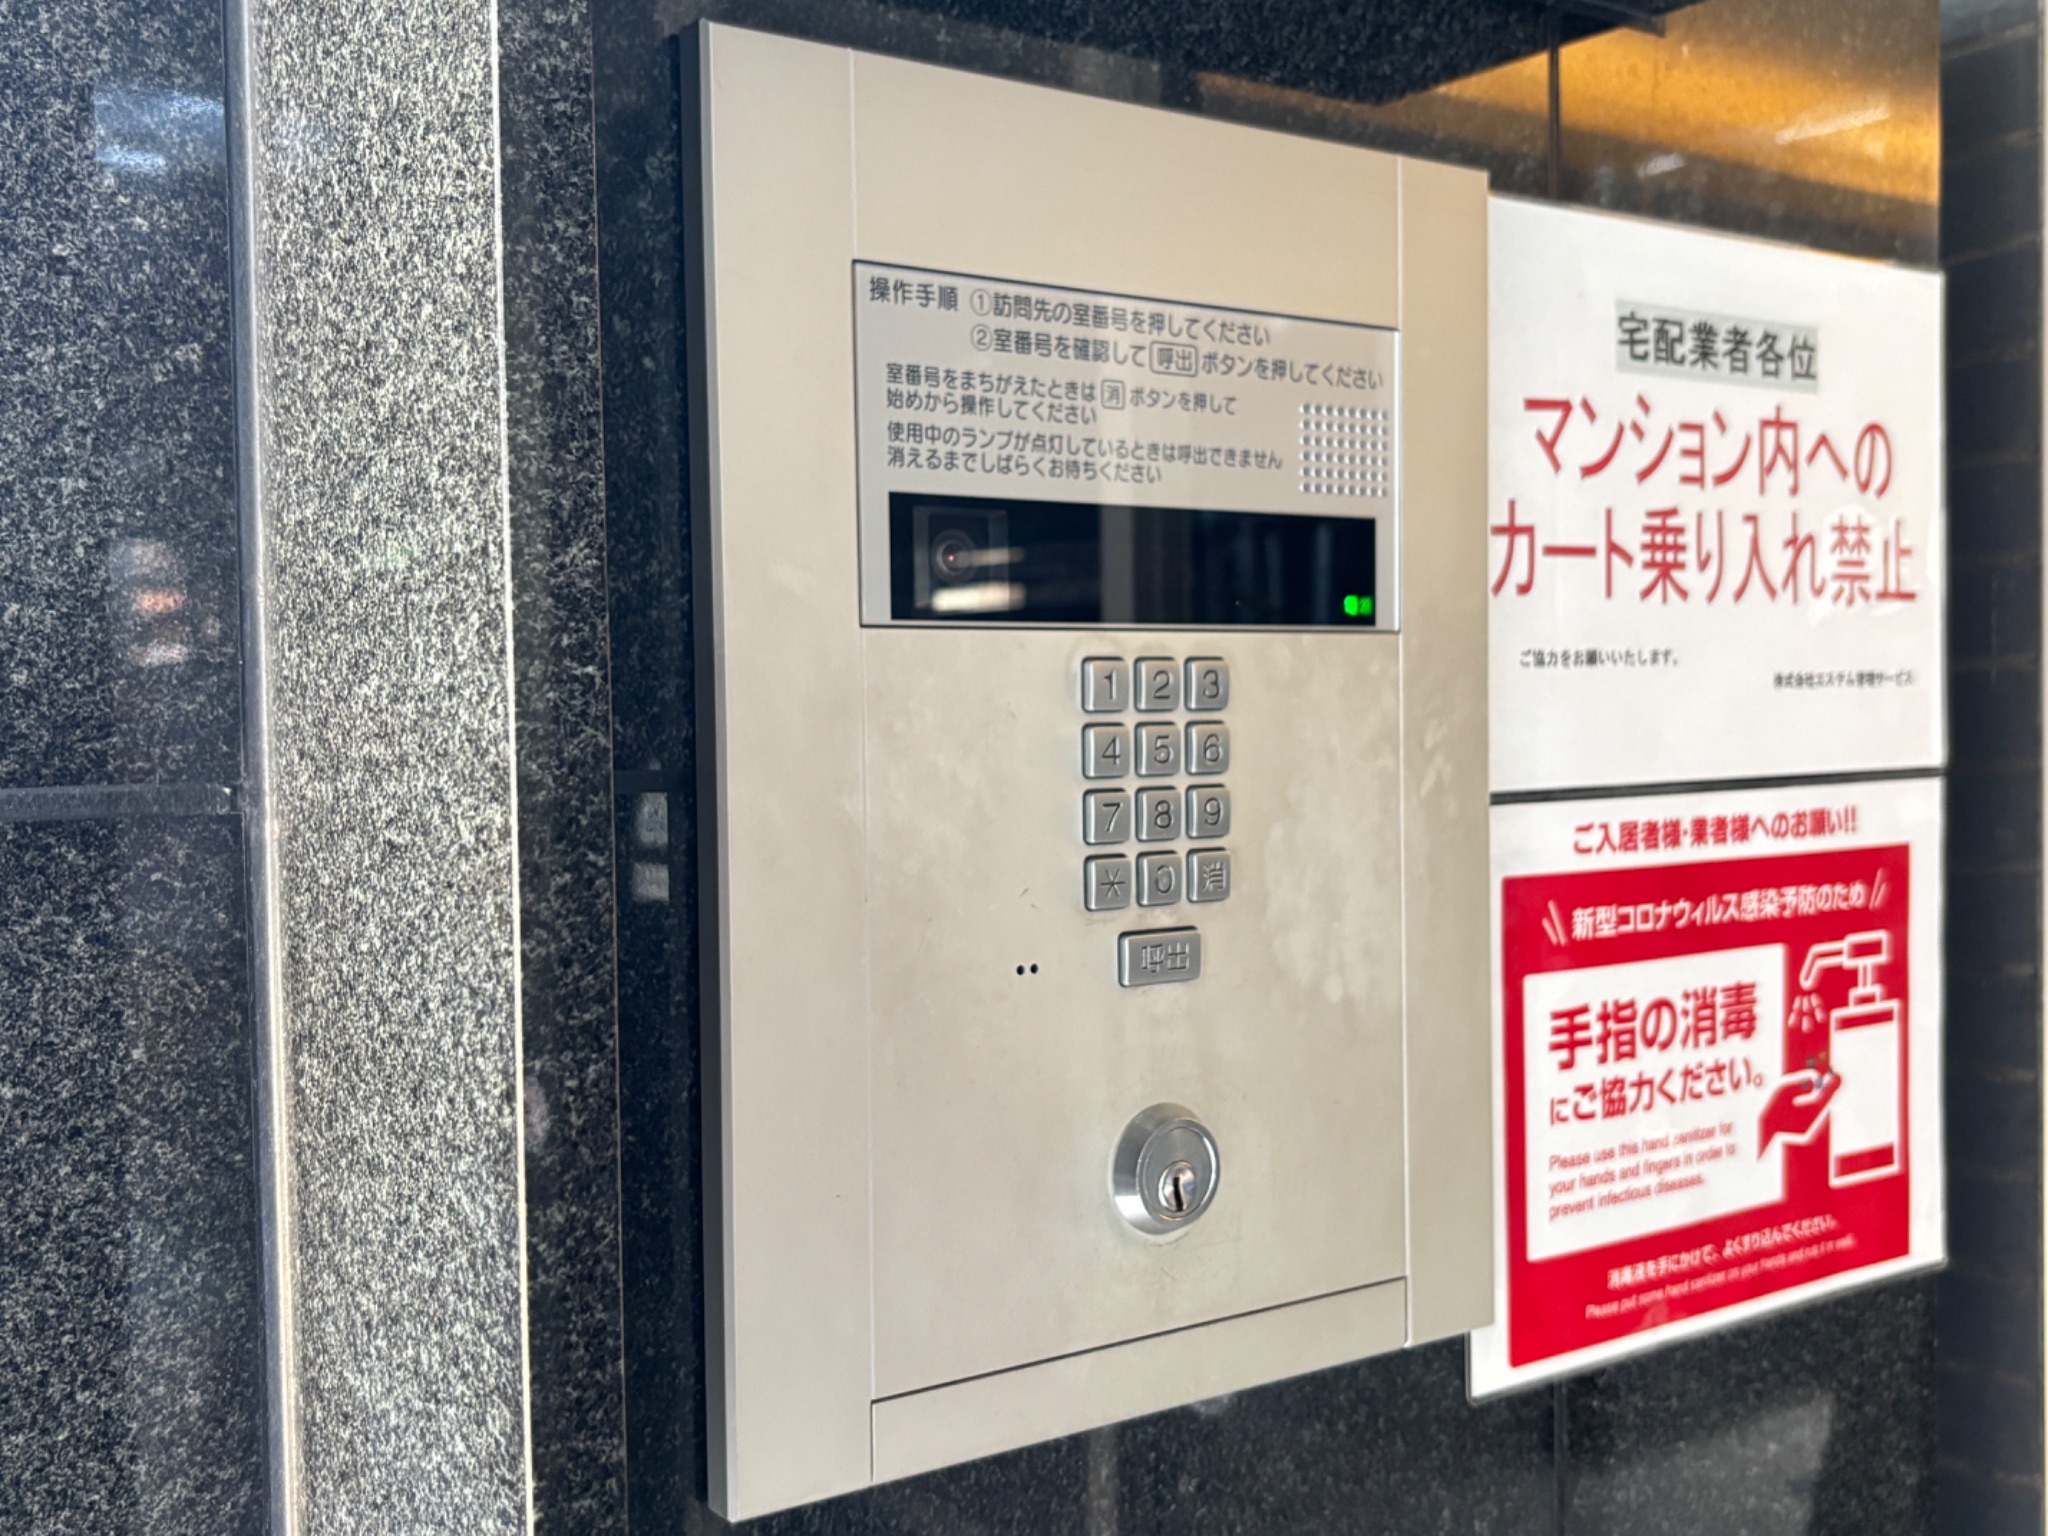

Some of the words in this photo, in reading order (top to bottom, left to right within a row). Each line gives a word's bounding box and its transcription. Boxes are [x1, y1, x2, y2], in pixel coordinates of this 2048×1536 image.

[869, 276, 959, 312] 操作手順
[970, 288, 1271, 347] ①訪問先の室番号を押してください
[970, 323, 1147, 368] ②室番号を確認して
[1156, 347, 1194, 373] 呼出
[1201, 352, 1384, 390] ボタンを押してください
[1616, 311, 1818, 381] 宅配業者各位
[886, 362, 1097, 402] 室番号をまちがえたときは
[1129, 388, 1237, 416] ボタンを押して
[886, 388, 1098, 426] 始めから操作してください
[887, 420, 1282, 471] 使用中のランプが点灯しているときは呼出できません
[887, 446, 1162, 484] 消えるまでしばらくお待ちください
[1523, 393, 1893, 499] マンション内への
[1490, 498, 1917, 606] カート乗り入れ禁止
[1519, 648, 1679, 668] ご協力をお願いいたします。
[1103, 669, 1117, 701] 1
[1152, 670, 1172, 700] 2
[1202, 669, 1221, 699] 3
[1100, 735, 1122, 766] 4
[1153, 734, 1172, 764] 5
[1203, 732, 1221, 763] 6
[1102, 802, 1123, 833] 7
[1154, 800, 1173, 830] 8
[1204, 797, 1222, 827] 9
[1154, 865, 1175, 895] 0
[1141, 942, 1190, 973] 呼出
[1548, 981, 1758, 1071] 手指の消毒
[1550, 1057, 1764, 1126] にご協力ください。
[1549, 1152, 1591, 1170] Please
[1594, 1147, 1615, 1162] use
[1618, 1142, 1639, 1158] this
[1641, 1134, 1670, 1152] hand
[1673, 1126, 1716, 1146] sanitizer
[1719, 1121, 1733, 1135] for
[1549, 1178, 1576, 1198] your
[1579, 1168, 1616, 1188] hands
[1619, 1163, 1640, 1179] and
[1643, 1155, 1681, 1176] fingers
[1683, 1151, 1693, 1165] in
[1696, 1145, 1723, 1163] order
[1549, 1197, 1595, 1222] prevent
[1597, 1185, 1652, 1207] infectious
